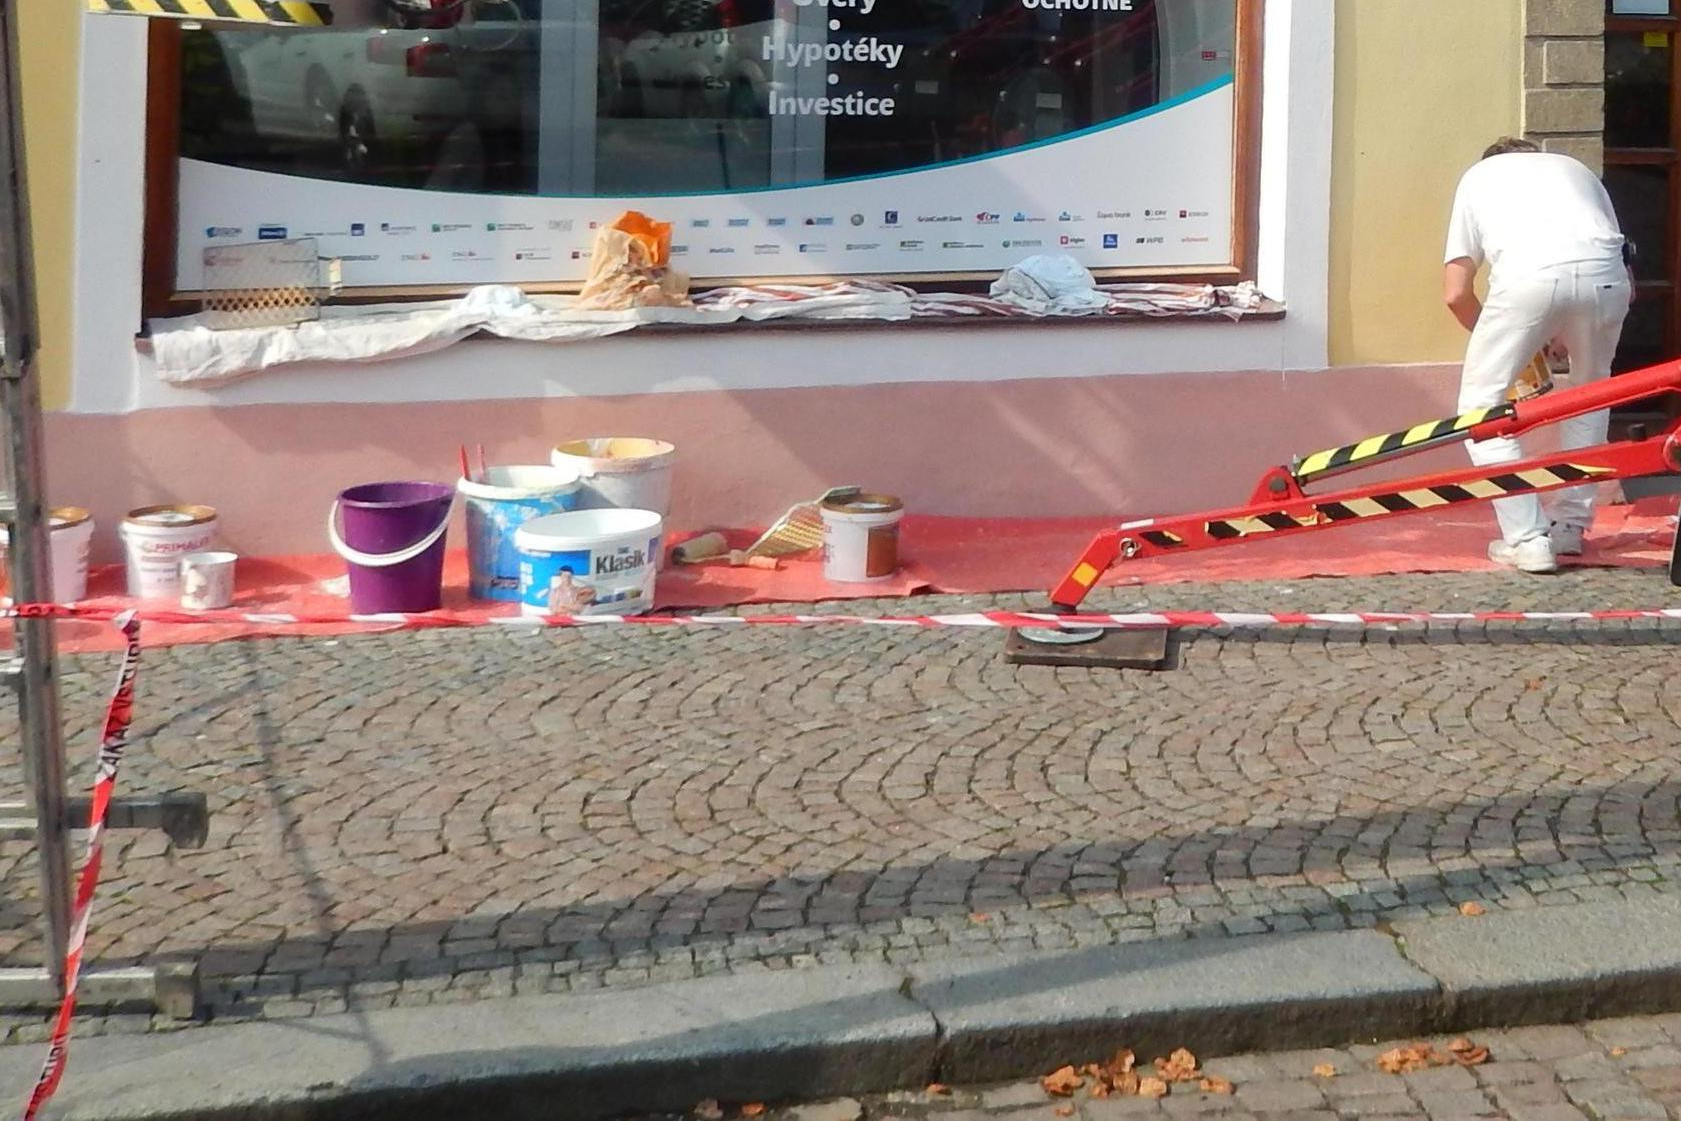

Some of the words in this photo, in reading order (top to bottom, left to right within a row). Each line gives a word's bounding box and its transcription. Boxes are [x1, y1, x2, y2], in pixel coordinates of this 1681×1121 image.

[762, 35, 903, 68] Hypotéky
[768, 90, 895, 116] Investice
[595, 548, 645, 574] Klasik
